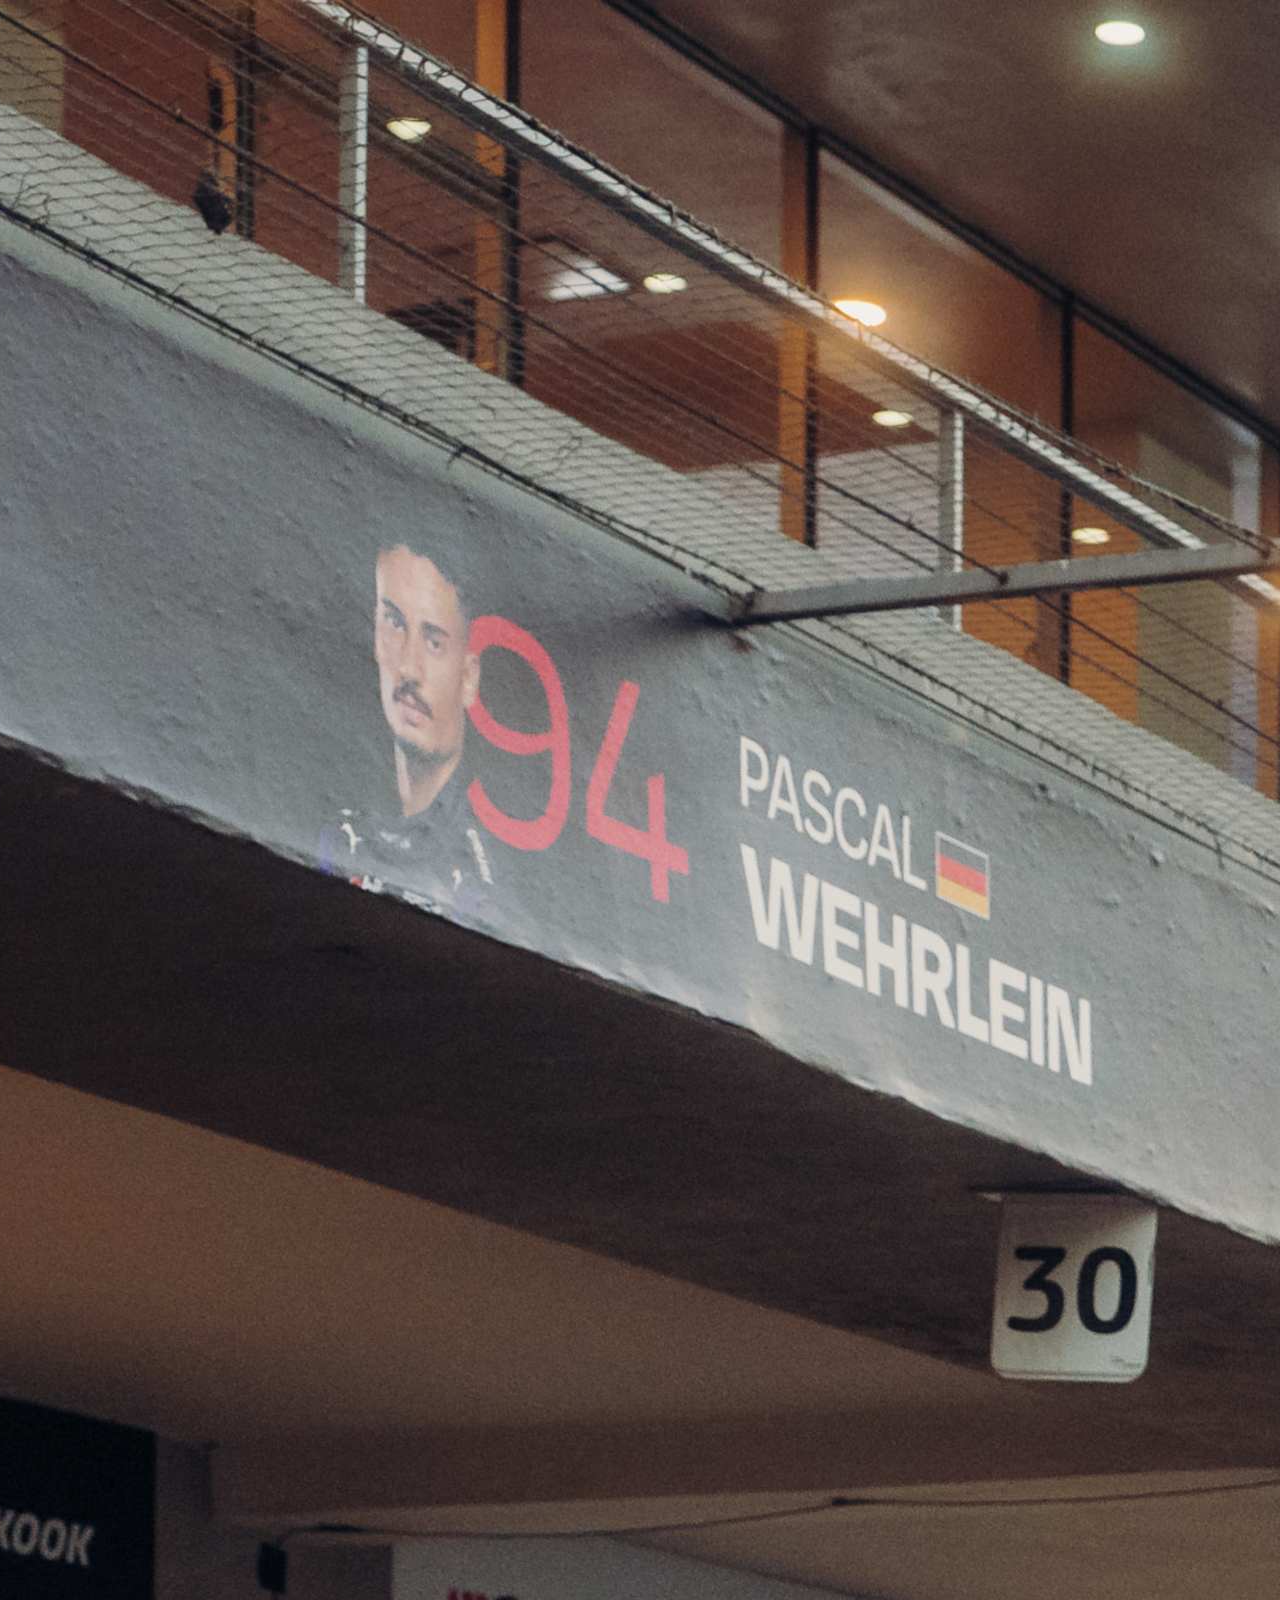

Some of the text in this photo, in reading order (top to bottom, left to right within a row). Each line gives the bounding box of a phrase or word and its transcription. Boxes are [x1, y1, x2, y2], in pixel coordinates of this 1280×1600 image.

[467, 615, 689, 904] 94
[740, 735, 928, 892] PASCAL
[740, 843, 1094, 1087] WEHRLEIN
[1006, 1245, 1138, 1335] 30
